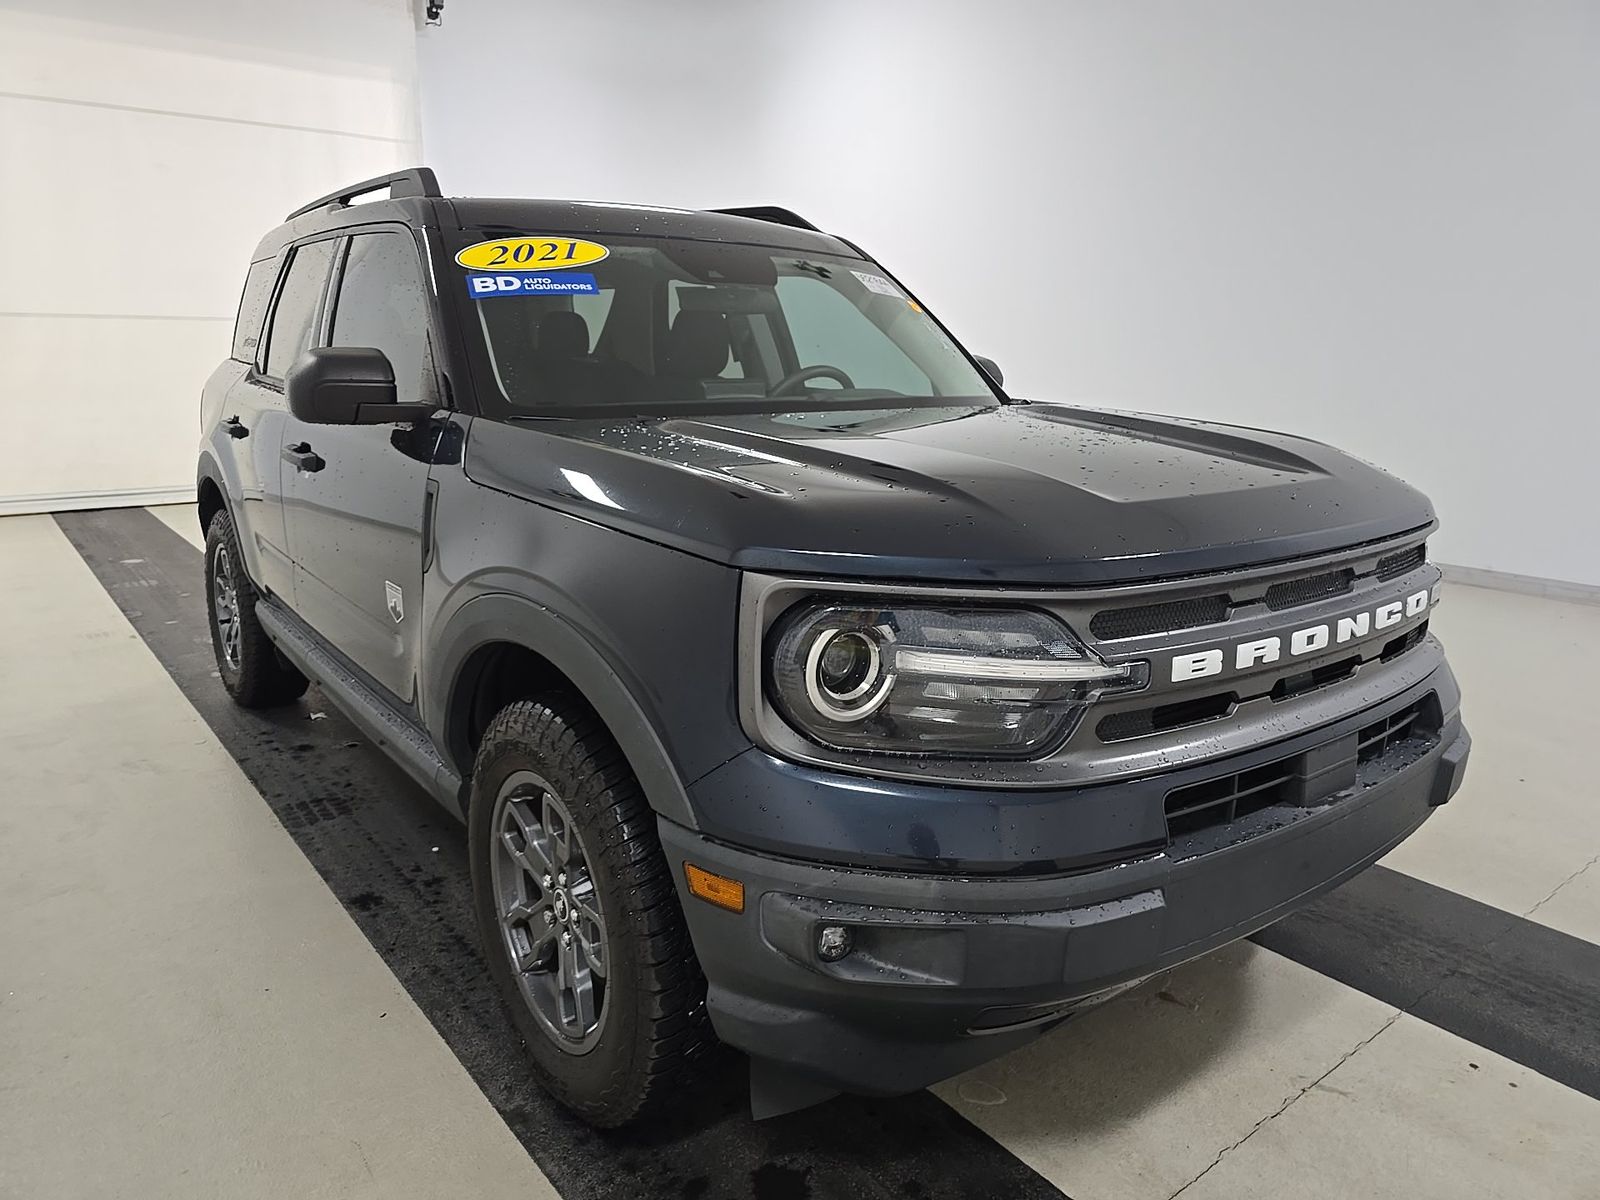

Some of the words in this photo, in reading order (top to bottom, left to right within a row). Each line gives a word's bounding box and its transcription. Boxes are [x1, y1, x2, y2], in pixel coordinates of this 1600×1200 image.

[486, 242, 578, 266] 2021
[472, 276, 522, 293] BD
[524, 283, 593, 291] LIQUIDATORS
[1171, 589, 1428, 683] BRONCO
